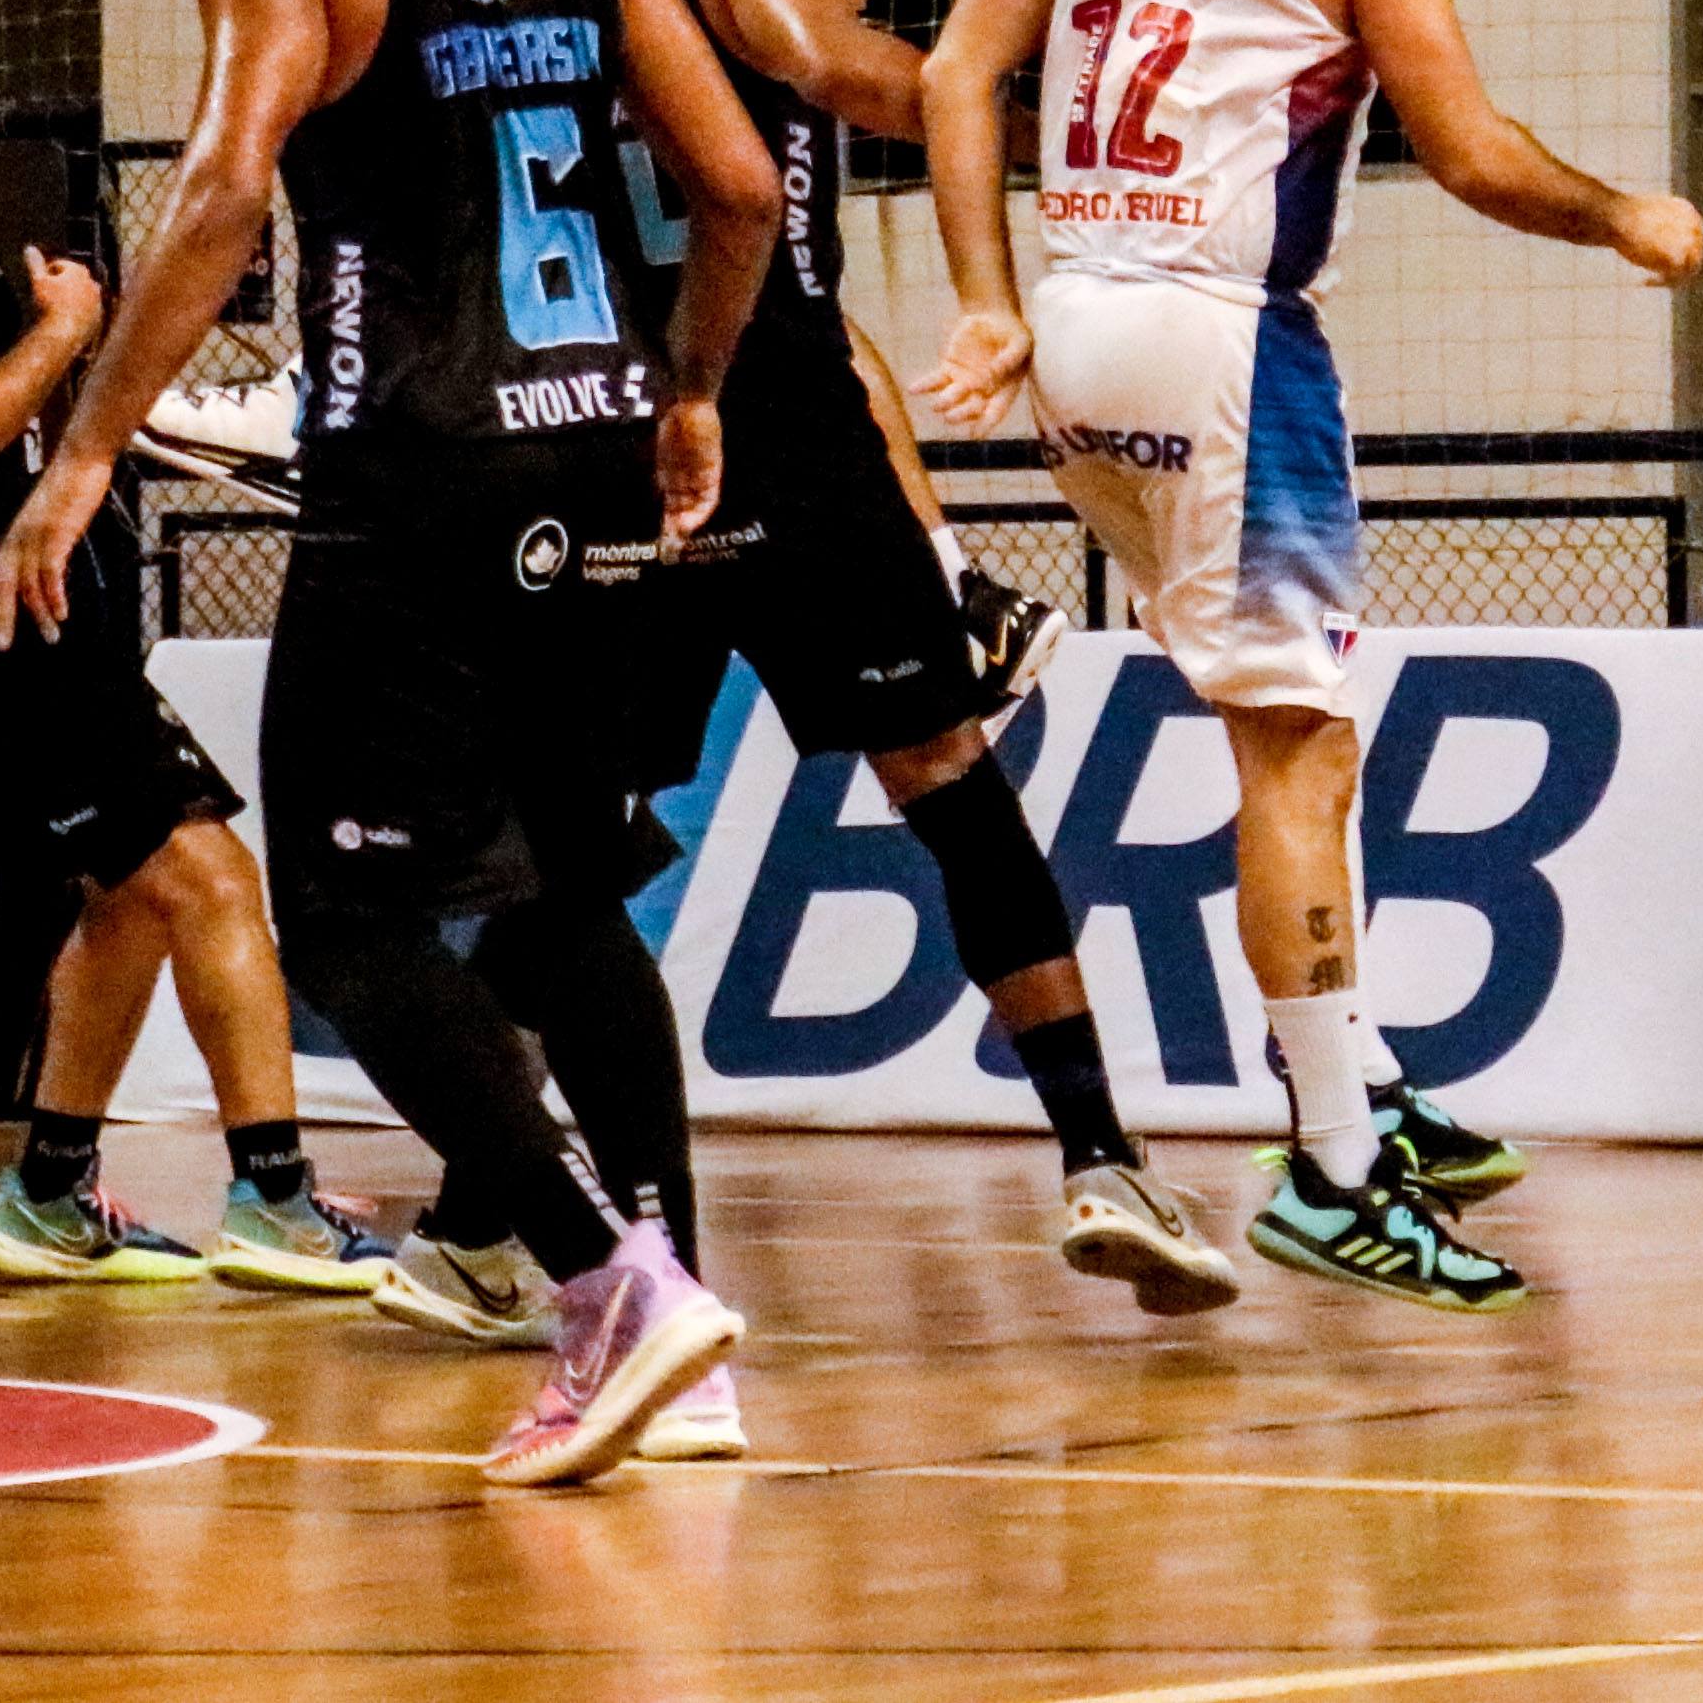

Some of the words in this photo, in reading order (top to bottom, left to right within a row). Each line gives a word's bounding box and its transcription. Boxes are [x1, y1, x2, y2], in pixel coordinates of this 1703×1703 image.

[495, 106, 619, 351] 6
[496, 372, 619, 430] EVOLVE
[701, 654, 1621, 1092] BRB
